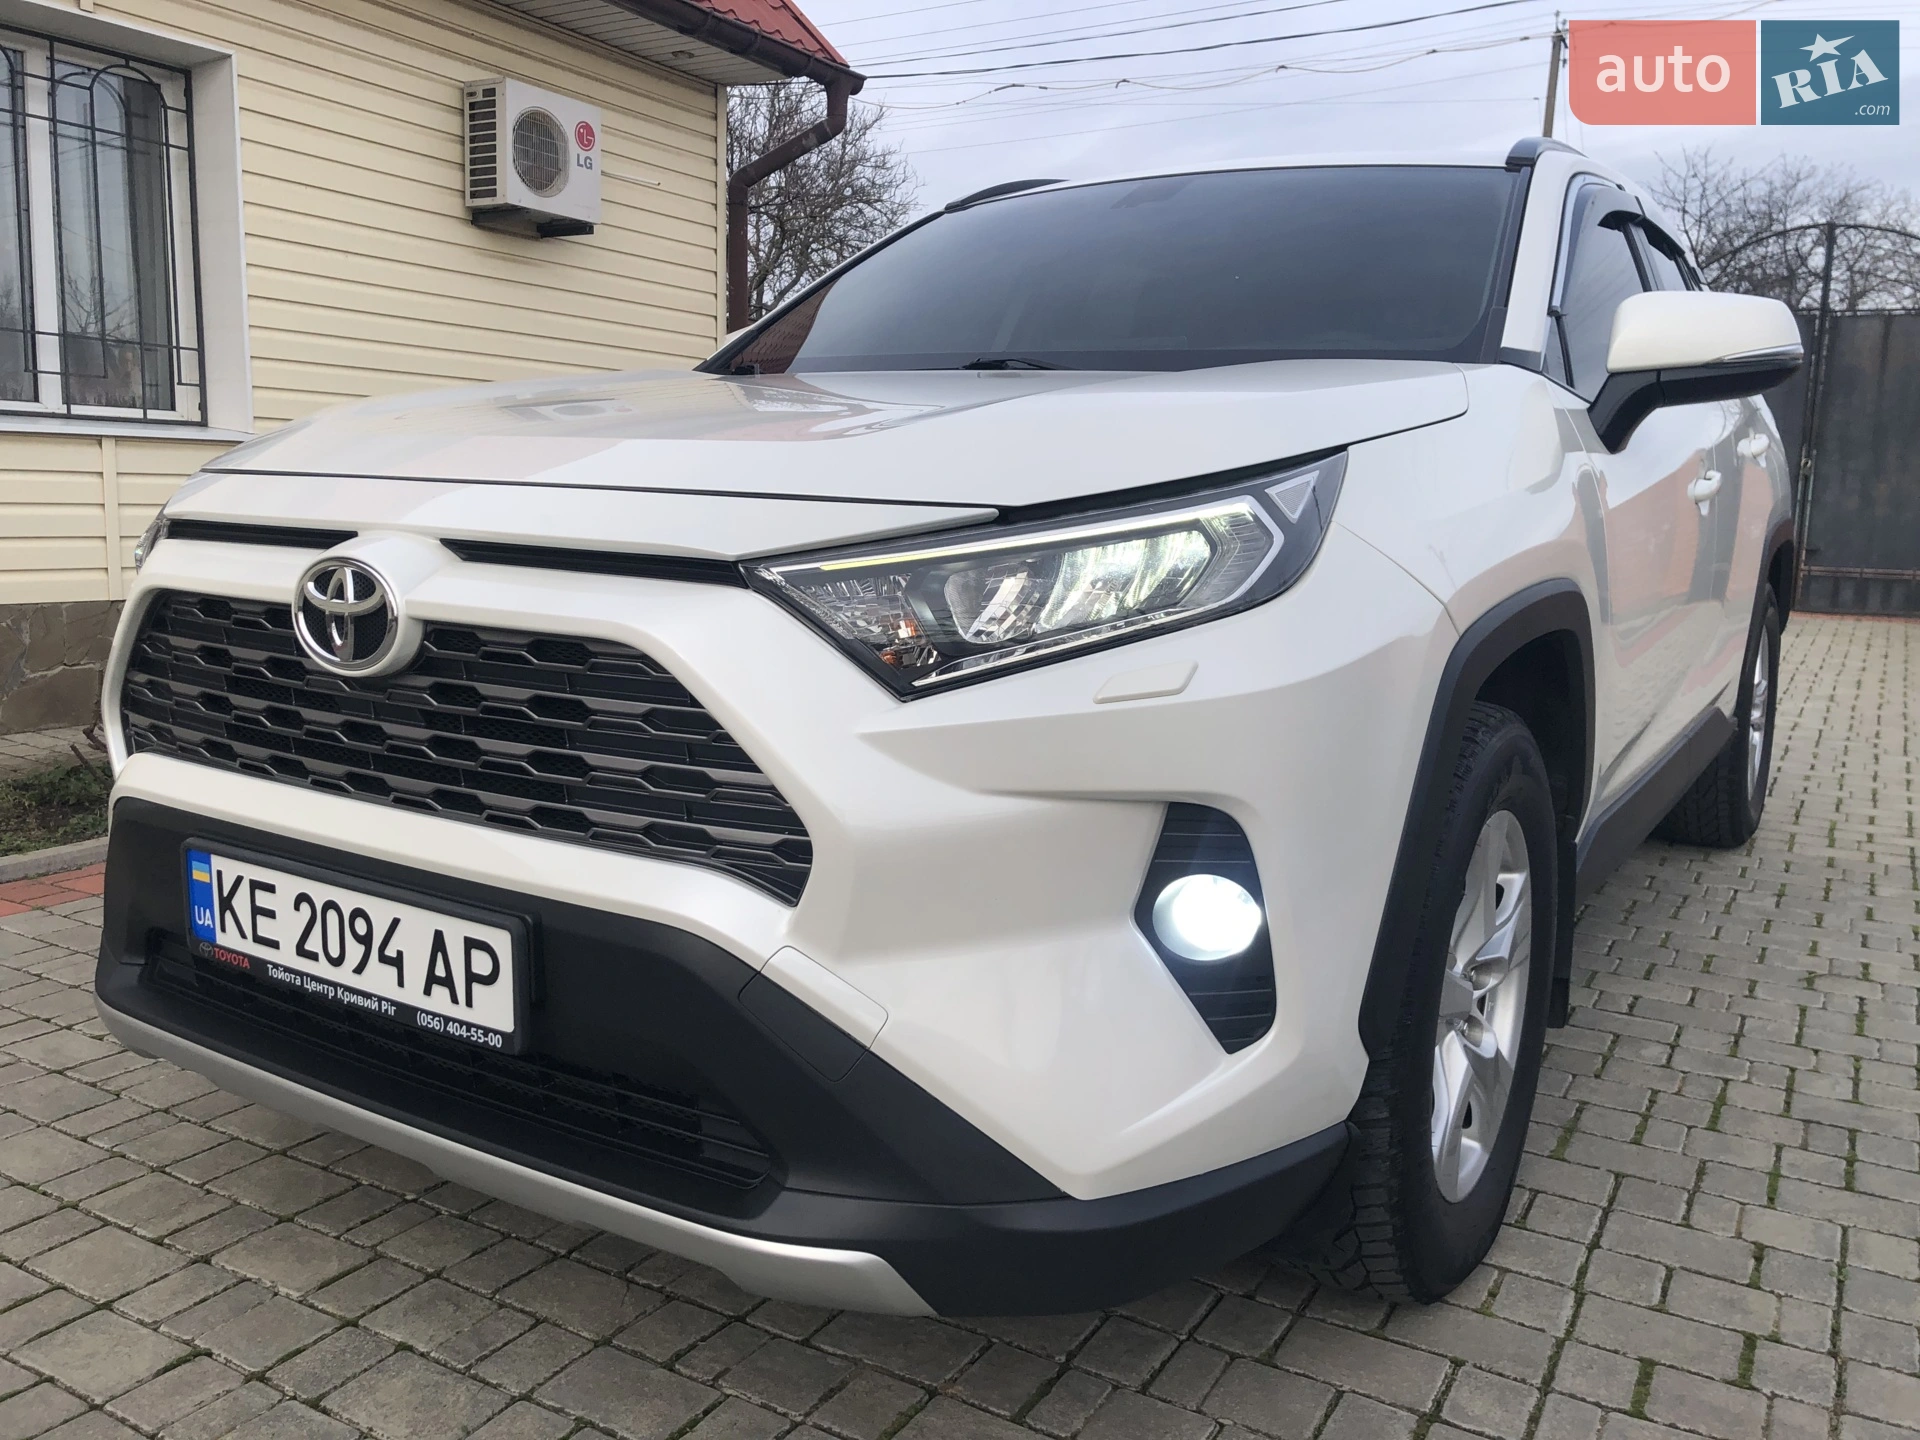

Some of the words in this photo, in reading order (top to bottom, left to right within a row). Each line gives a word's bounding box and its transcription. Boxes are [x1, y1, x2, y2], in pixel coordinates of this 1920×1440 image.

[576, 153, 593, 171] LG
[194, 905, 214, 929] UA
[216, 868, 281, 951] KE
[293, 892, 405, 988] 2094
[423, 928, 501, 1009] AP
[213, 947, 250, 969] TOYOTA
[267, 964, 302, 986] Тойота
[303, 976, 335, 999] Центр
[337, 987, 379, 1011] Кривий
[381, 999, 397, 1016] Ріг
[416, 1010, 444, 1033] (056)
[446, 1021, 503, 1048] 404-55-00
